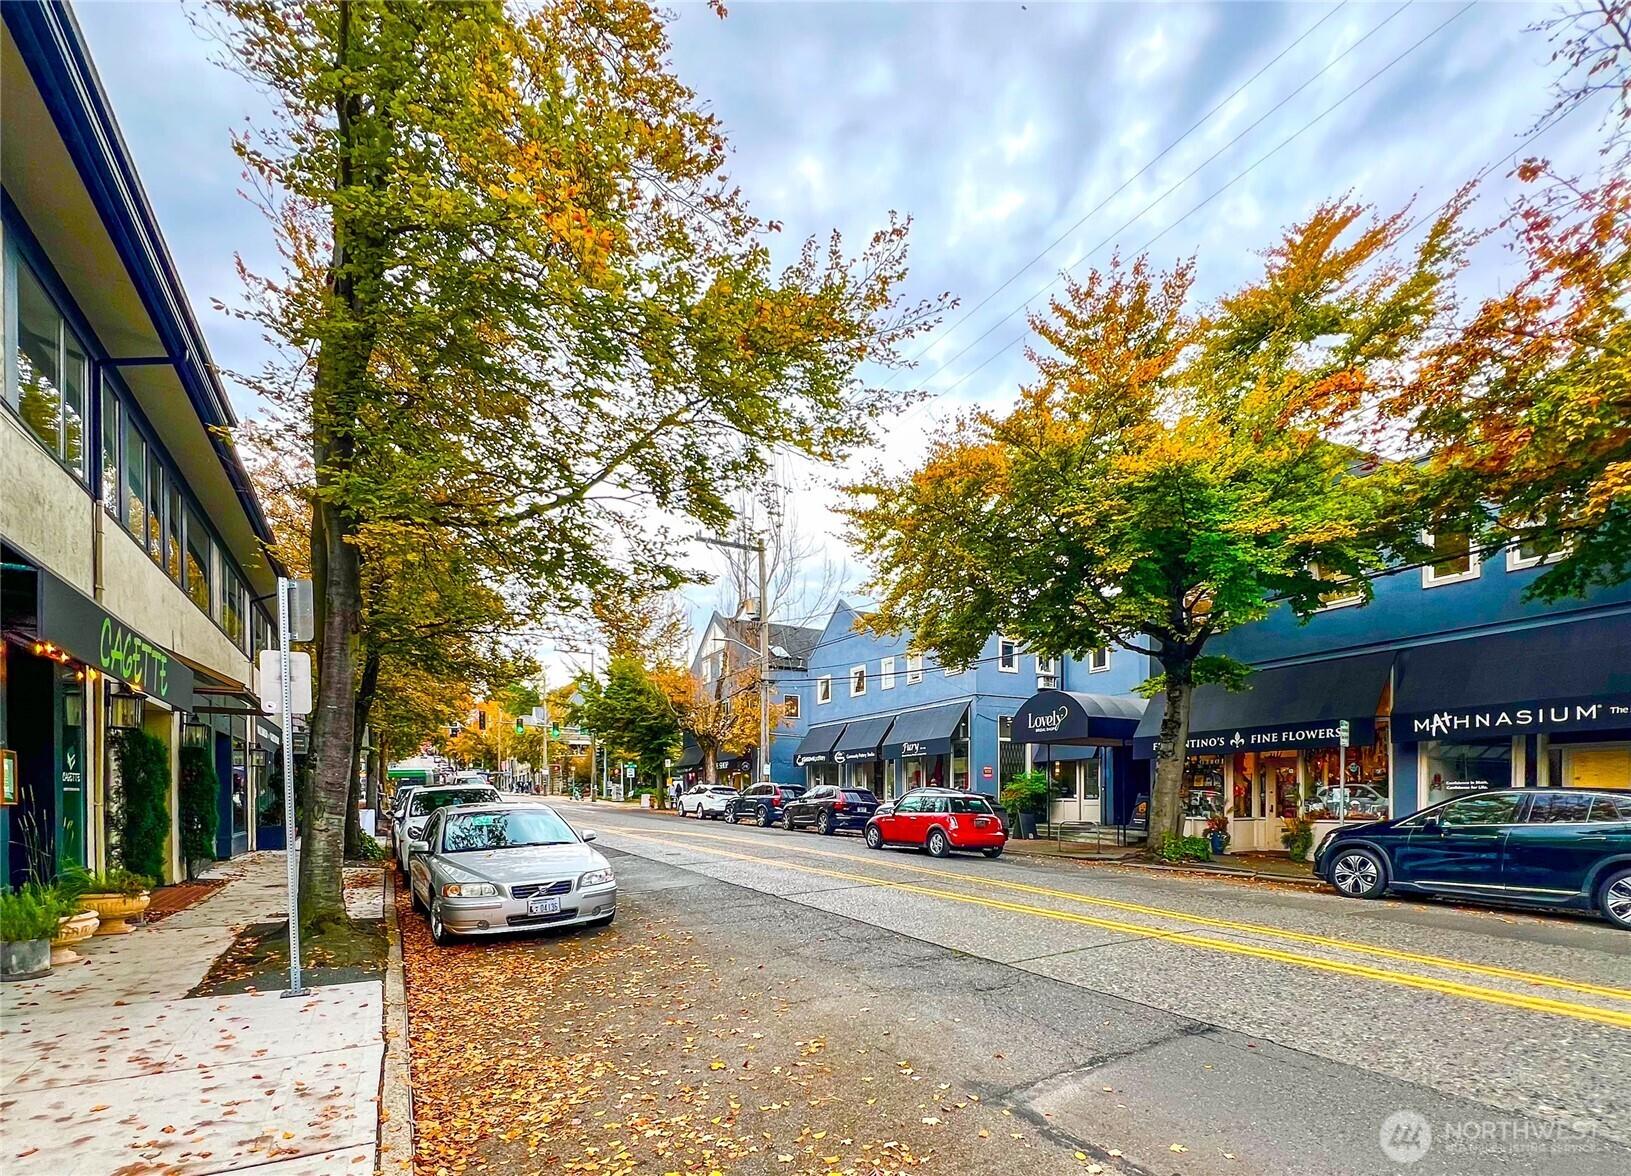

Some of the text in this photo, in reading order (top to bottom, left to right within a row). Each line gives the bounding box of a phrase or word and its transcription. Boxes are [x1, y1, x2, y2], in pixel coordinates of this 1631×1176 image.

[101, 617, 168, 696] CAGETTE
[1028, 706, 1068, 731] Lovely
[1610, 706, 1629, 714] The
[1251, 733, 1278, 744] FINE
[1282, 727, 1341, 742] FLOWERS
[902, 742, 920, 754] Fury
